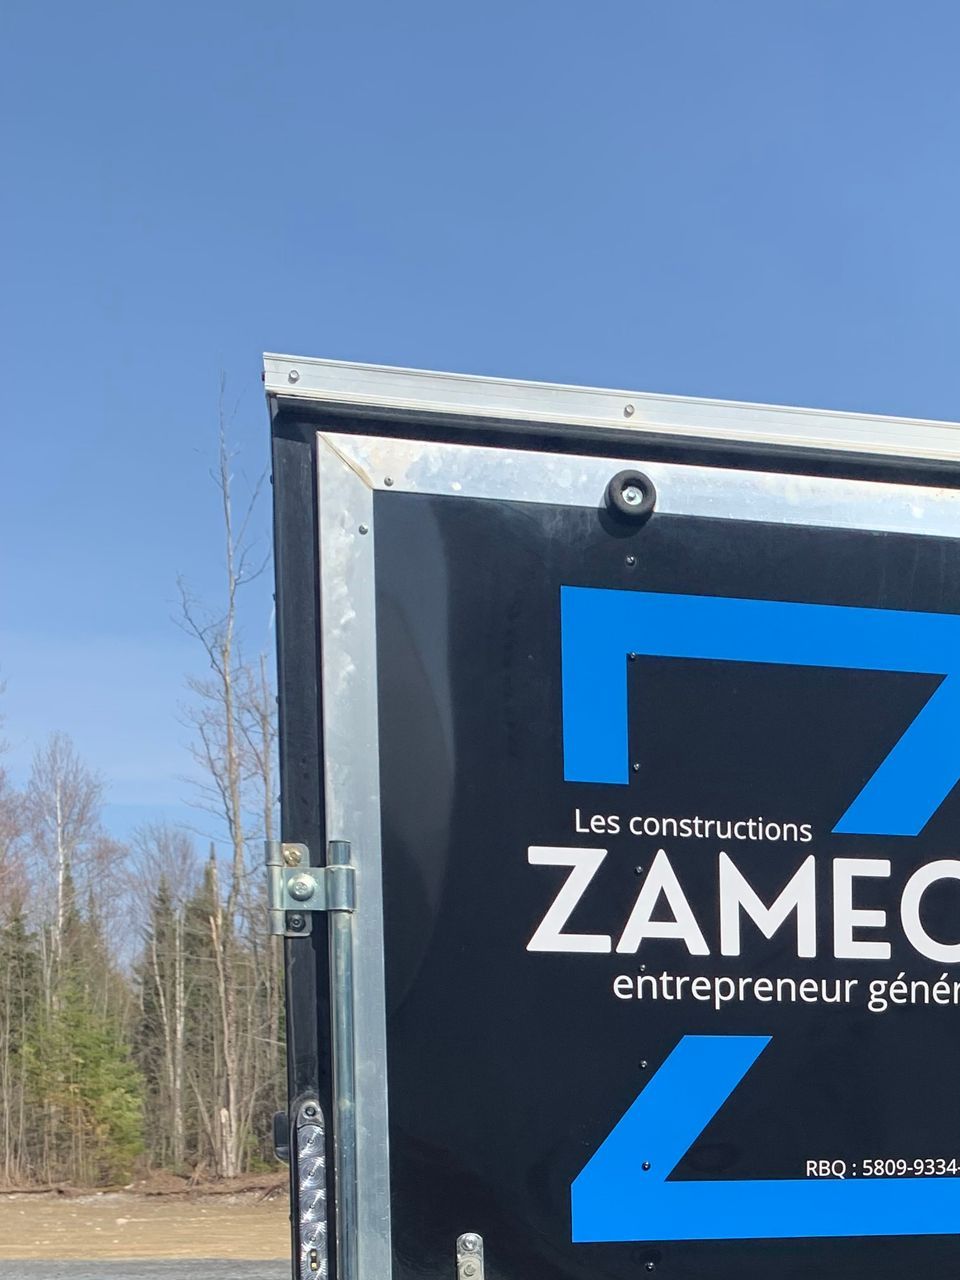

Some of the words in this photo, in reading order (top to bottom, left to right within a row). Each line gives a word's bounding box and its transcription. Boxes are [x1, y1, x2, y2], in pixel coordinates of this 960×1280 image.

[575, 808, 621, 835] Les
[629, 815, 814, 843] constructions
[613, 971, 859, 1011] entrepreneur
[806, 1159, 847, 1180] RBQ
